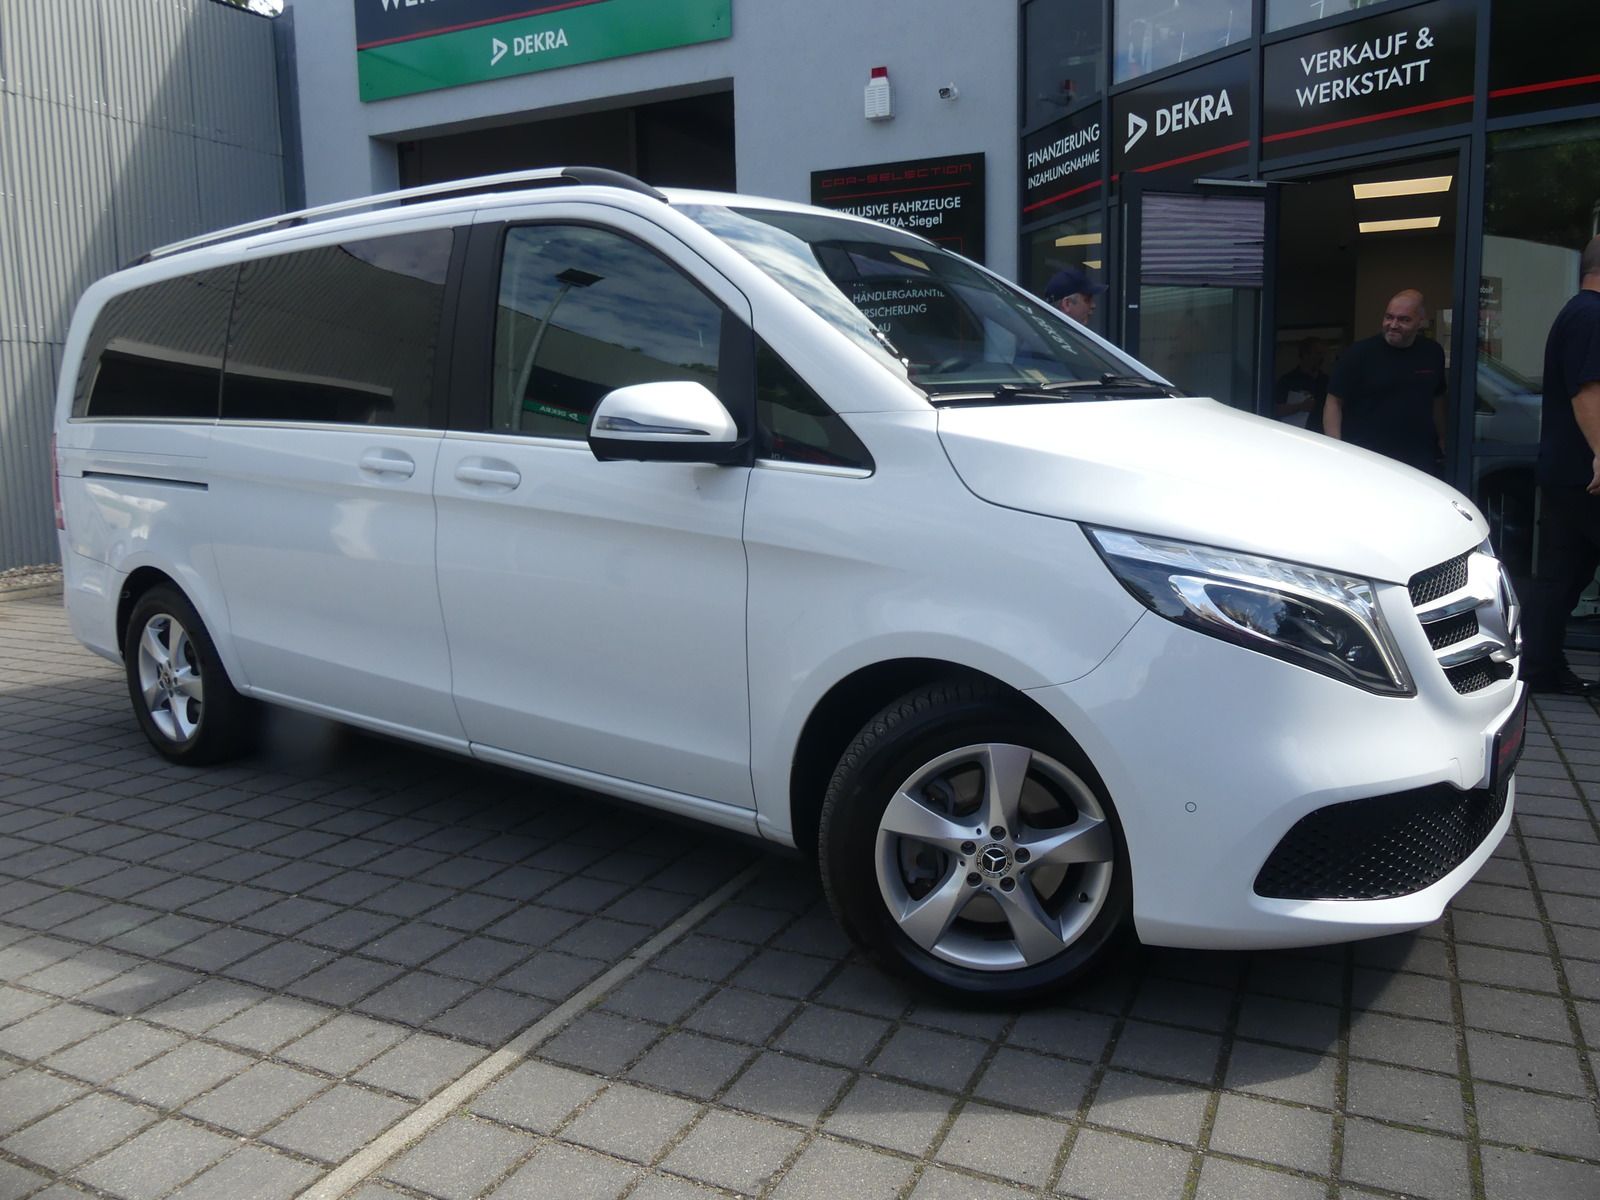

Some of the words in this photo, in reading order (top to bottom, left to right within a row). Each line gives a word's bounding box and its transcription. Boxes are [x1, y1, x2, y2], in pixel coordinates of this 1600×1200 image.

[513, 28, 568, 56] DEKRA
[1300, 31, 1408, 76] VERKAUF
[1415, 26, 1434, 49] &
[1295, 59, 1431, 108] WERKSTATT
[1156, 88, 1233, 137] DEKRA
[1028, 123, 1100, 170] FINANZIERUNG
[1028, 149, 1100, 190] INZAHLUNGNAHME
[892, 196, 961, 214] FAHRZEUGE
[861, 304, 927, 318] ERSICHERUNG
